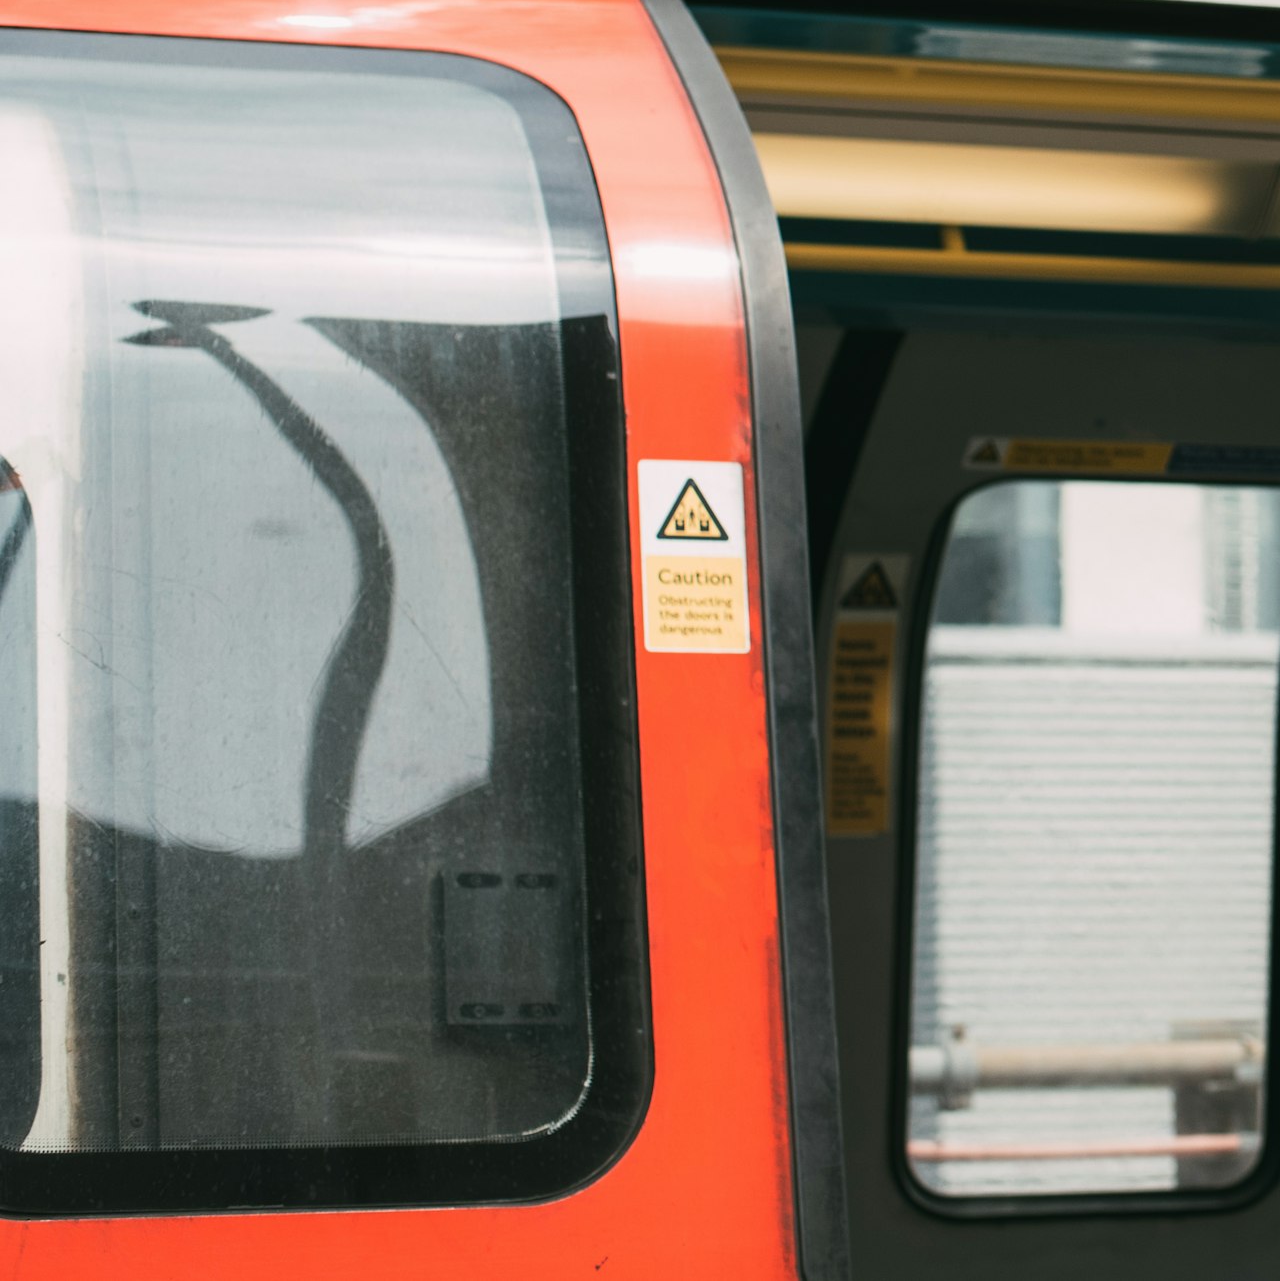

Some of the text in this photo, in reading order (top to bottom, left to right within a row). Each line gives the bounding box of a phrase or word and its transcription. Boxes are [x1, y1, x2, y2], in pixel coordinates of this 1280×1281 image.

[658, 568, 733, 586] Caution
[658, 595, 732, 608] Obstructing
[659, 610, 733, 620] the doors is
[659, 622, 722, 636] dangerous
